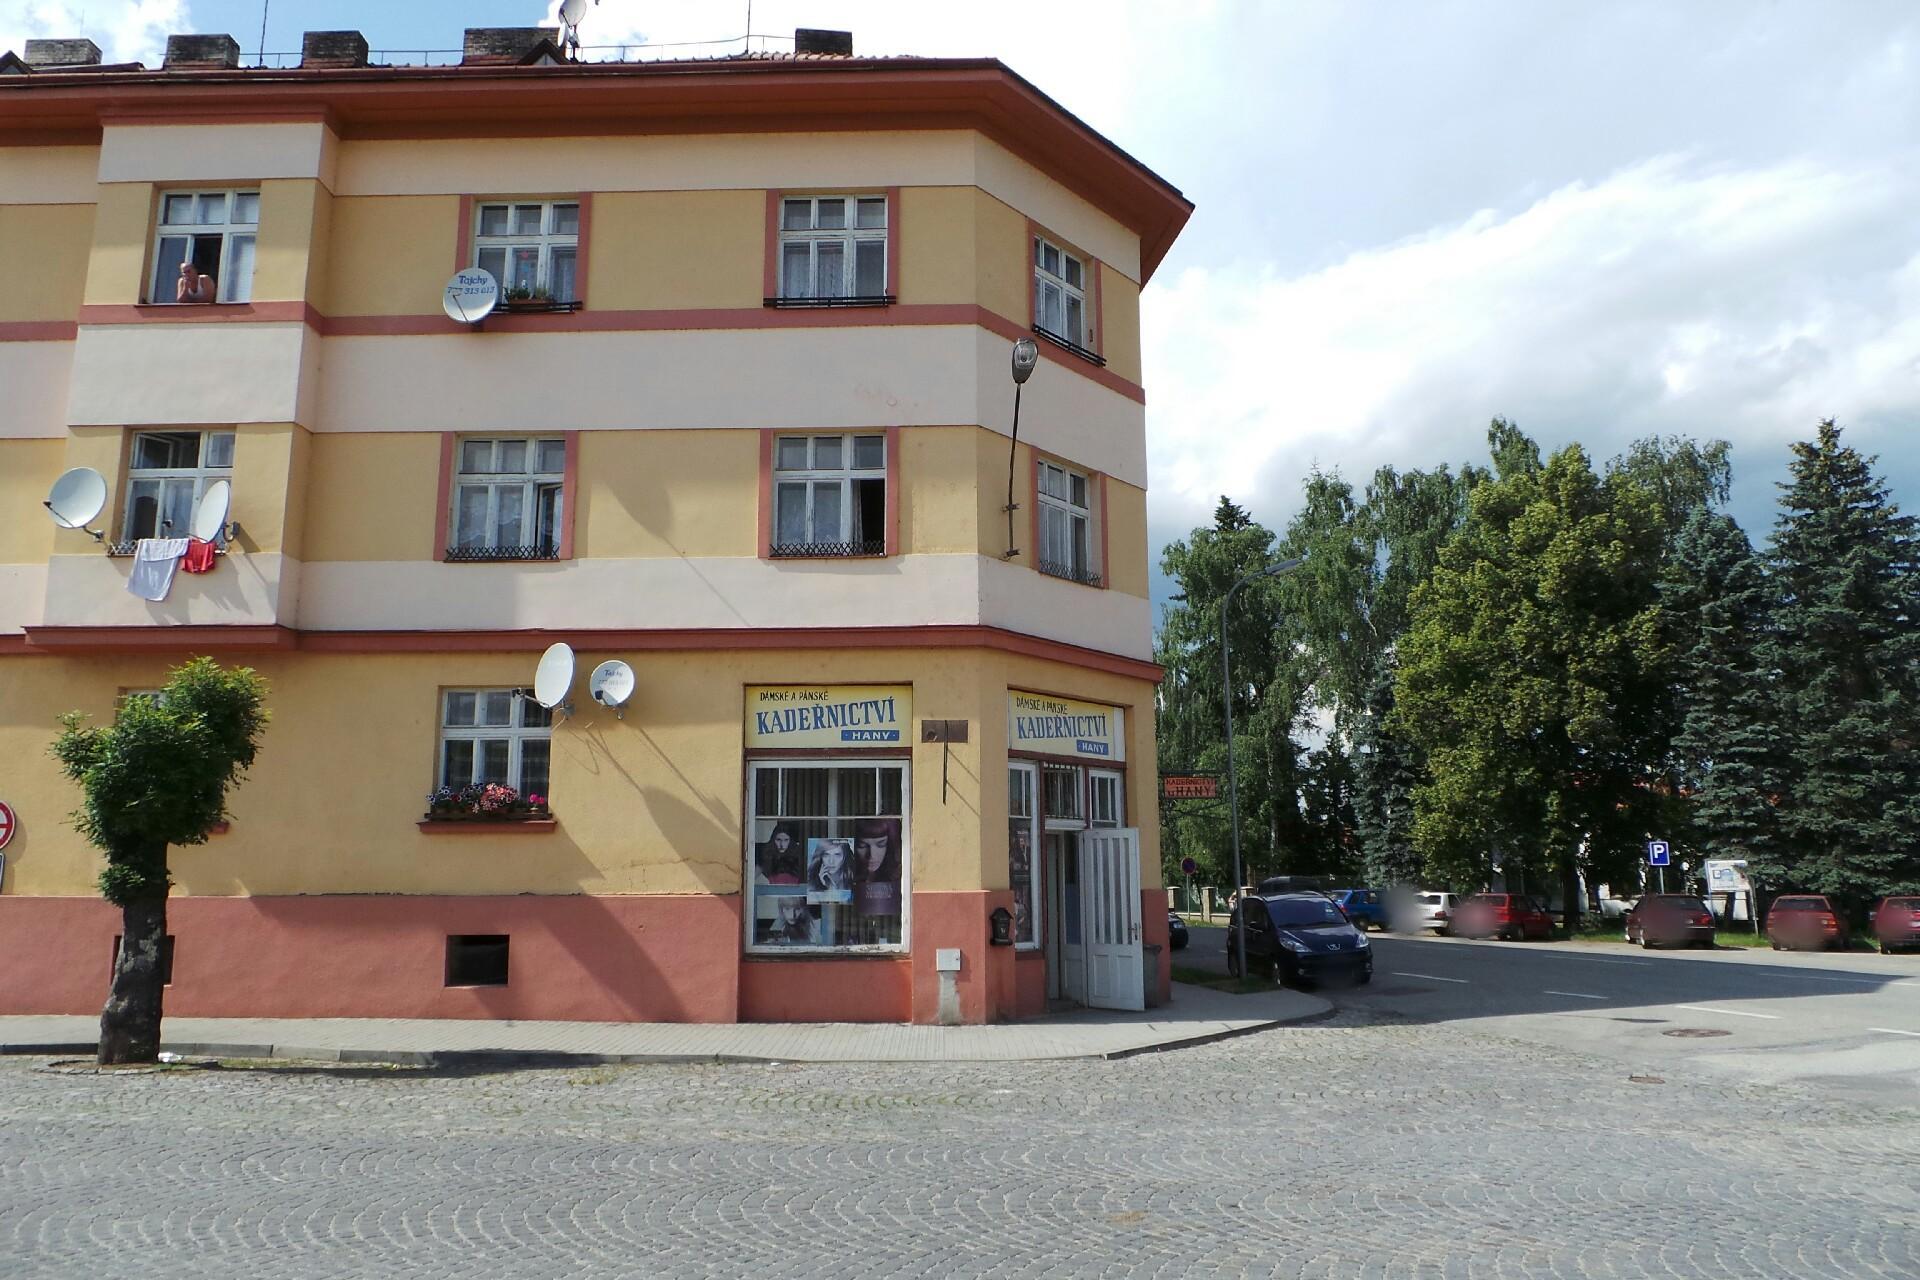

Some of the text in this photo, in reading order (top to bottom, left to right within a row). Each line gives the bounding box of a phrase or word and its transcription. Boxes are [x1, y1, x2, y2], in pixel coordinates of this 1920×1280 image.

[760, 690, 829, 701] DÁMSKÉ A PÁNSKÉ
[756, 696, 896, 735] KADEŘNICTVÍ
[1016, 712, 1107, 739] KADEŘNICTVÍ
[852, 731, 890, 740] HANY
[1081, 742, 1105, 753] HANY
[1176, 786, 1212, 797] HANY
[1653, 844, 1664, 858] P
